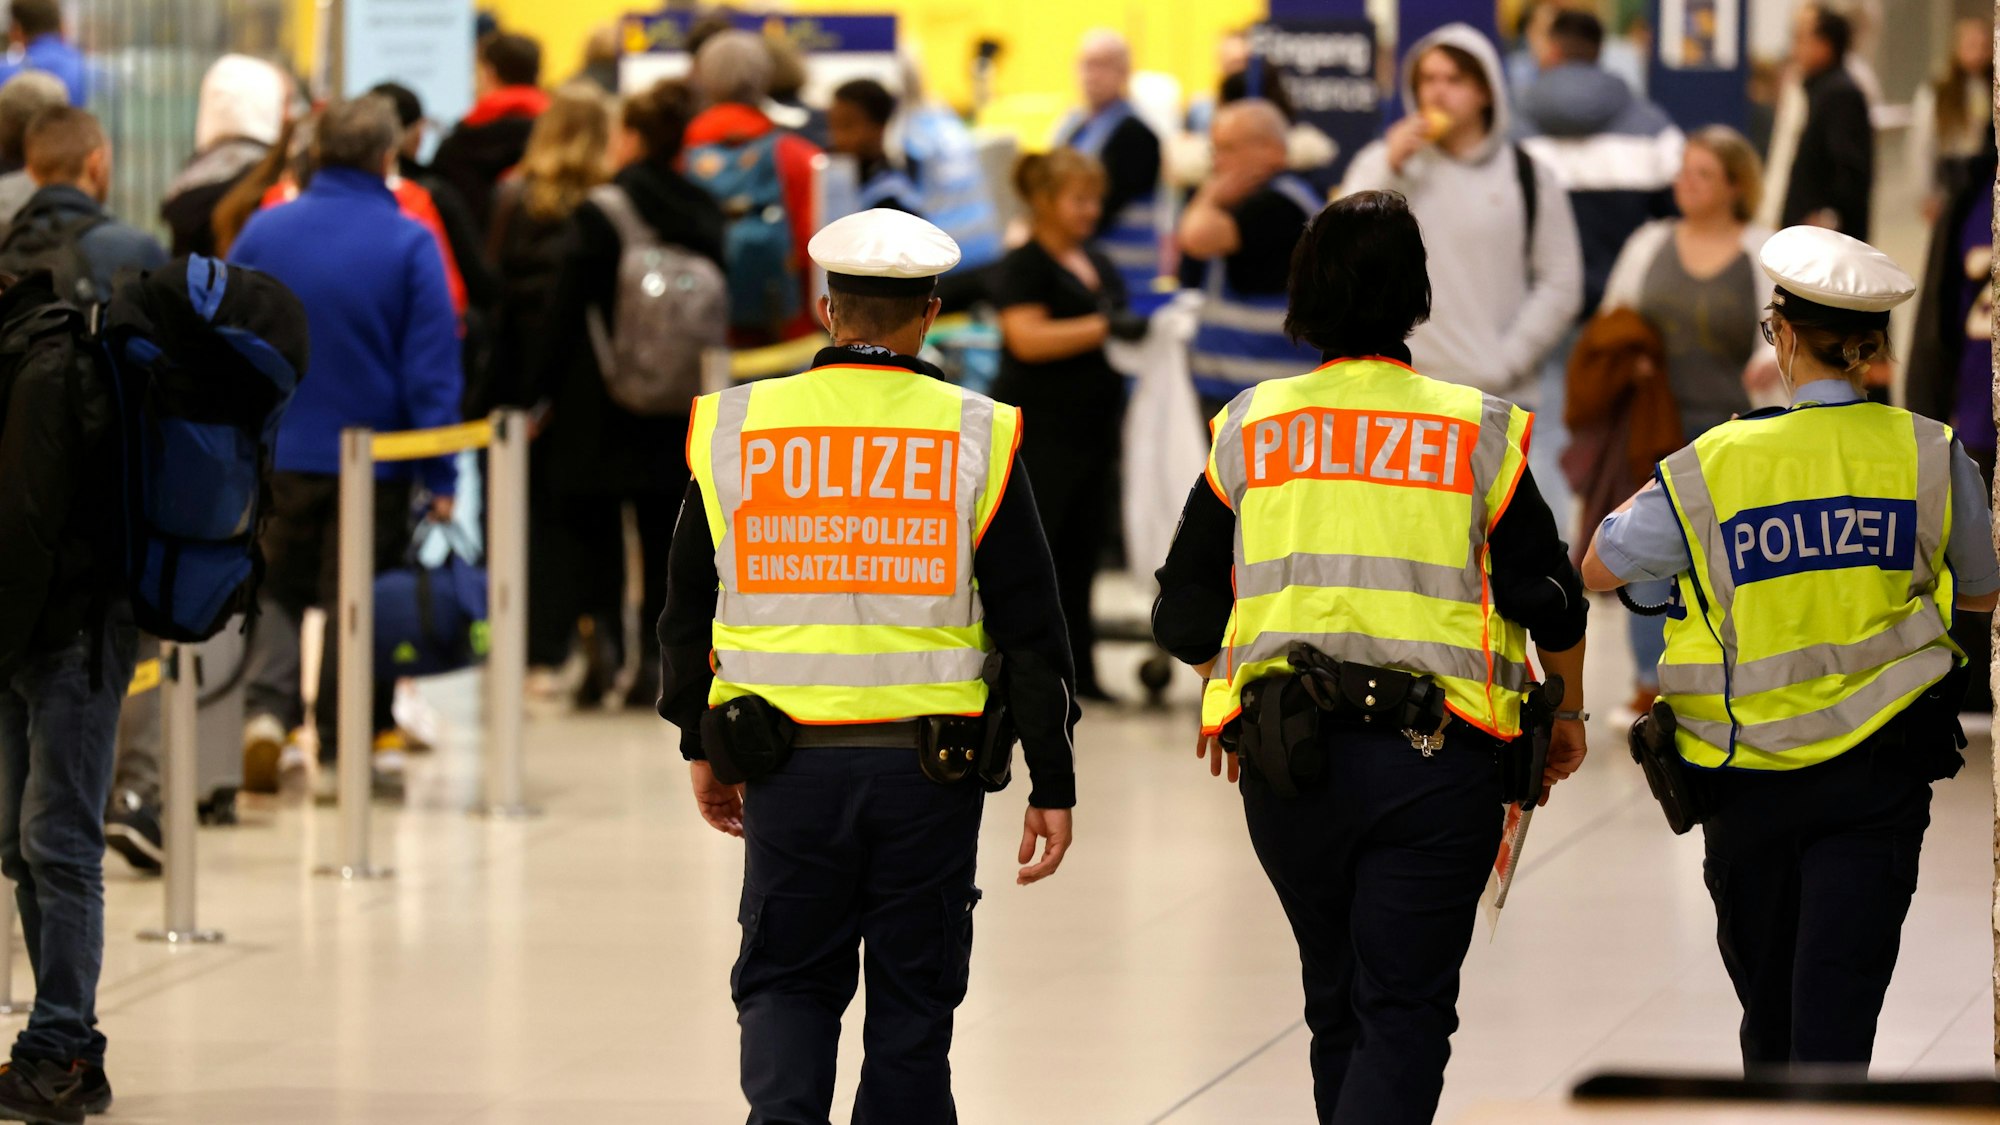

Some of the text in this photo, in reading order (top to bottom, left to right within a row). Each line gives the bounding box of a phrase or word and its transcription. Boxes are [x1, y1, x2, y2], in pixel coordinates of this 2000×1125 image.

[742, 436, 953, 501] POLIZEI
[1254, 413, 1460, 485] POLIZEI
[746, 515, 947, 546] BUNDESPOLIZEI
[1734, 508, 1897, 570] POLIZEI
[747, 554, 946, 584] EINSATZLEITUNG
